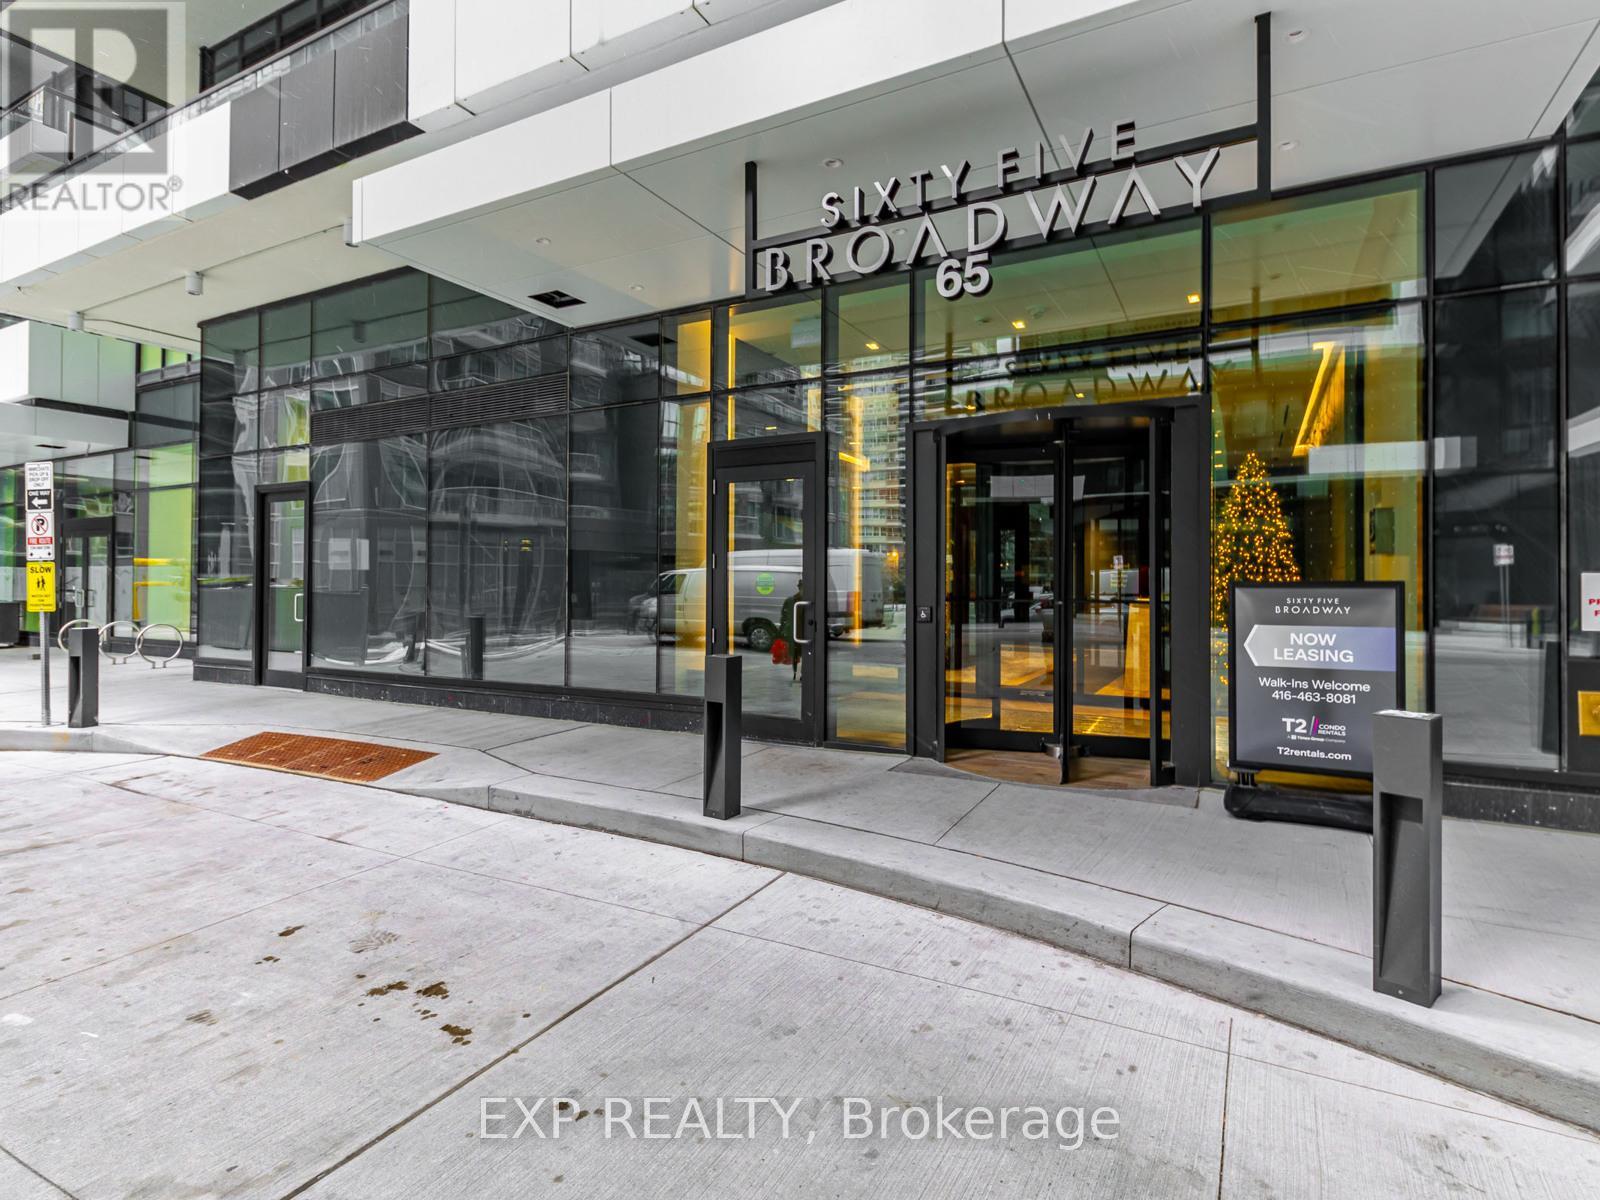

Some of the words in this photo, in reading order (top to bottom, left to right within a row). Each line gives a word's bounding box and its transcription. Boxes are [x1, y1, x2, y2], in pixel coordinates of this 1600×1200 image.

[821, 160, 971, 228] SIXTY
[998, 120, 1136, 188] FIVE
[765, 147, 1220, 292] BROADWAY
[936, 253, 991, 299] 65
[1286, 597, 1313, 605] SIXTY
[1275, 606, 1350, 615] BROADWAY
[1290, 633, 1336, 646] NOW
[1273, 648, 1354, 663] LEASING
[1258, 677, 1308, 689] Walk-Ins
[1311, 680, 1371, 692] Welcome
[1271, 690, 1356, 705] 416-463-8081
[1281, 717, 1307, 734] T2
[1276, 746, 1352, 761] T2rentals.com
